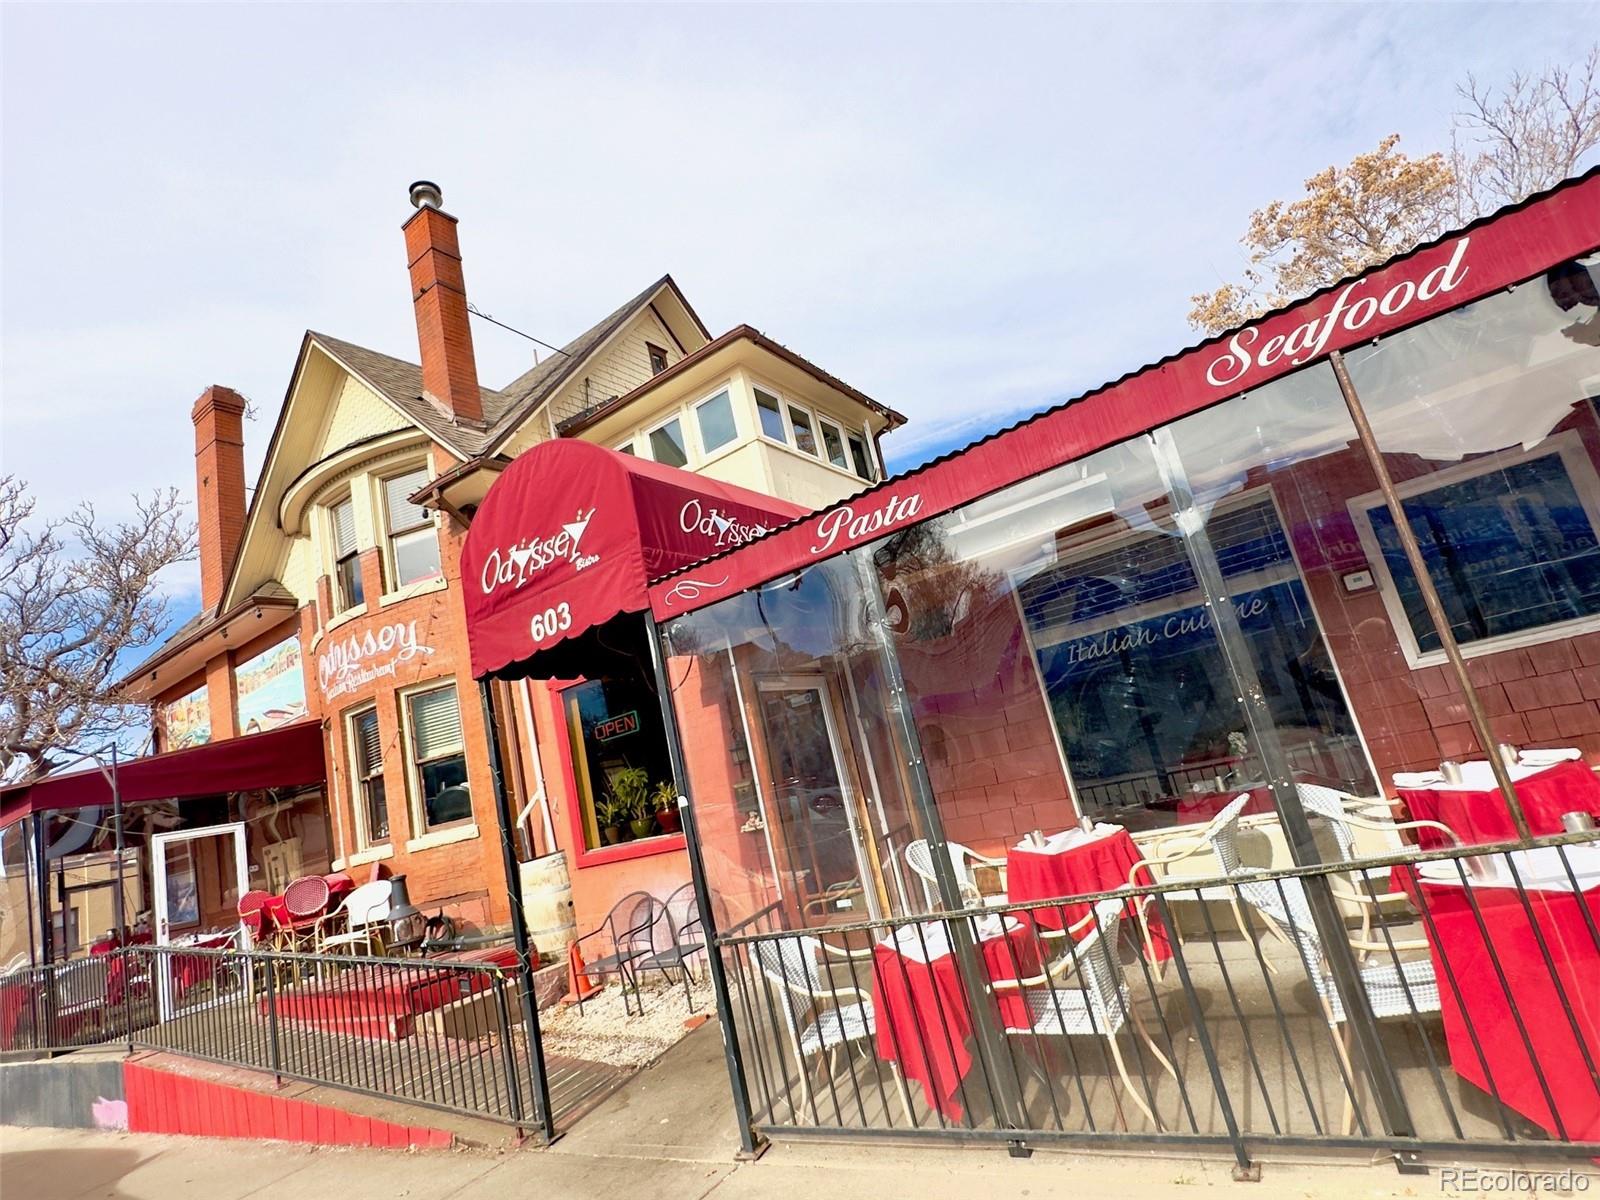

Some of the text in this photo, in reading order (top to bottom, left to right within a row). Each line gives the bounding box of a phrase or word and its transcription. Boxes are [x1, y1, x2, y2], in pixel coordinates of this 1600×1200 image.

[1206, 237, 1470, 386] Seafood
[481, 507, 596, 594] Odyssey
[811, 491, 923, 555] Pasta
[575, 554, 600, 572] Bistro
[318, 620, 436, 690] Odyssey
[530, 602, 573, 643] 603
[1067, 598, 1269, 665] Italian Cuine
[595, 715, 637, 741] OPEN
